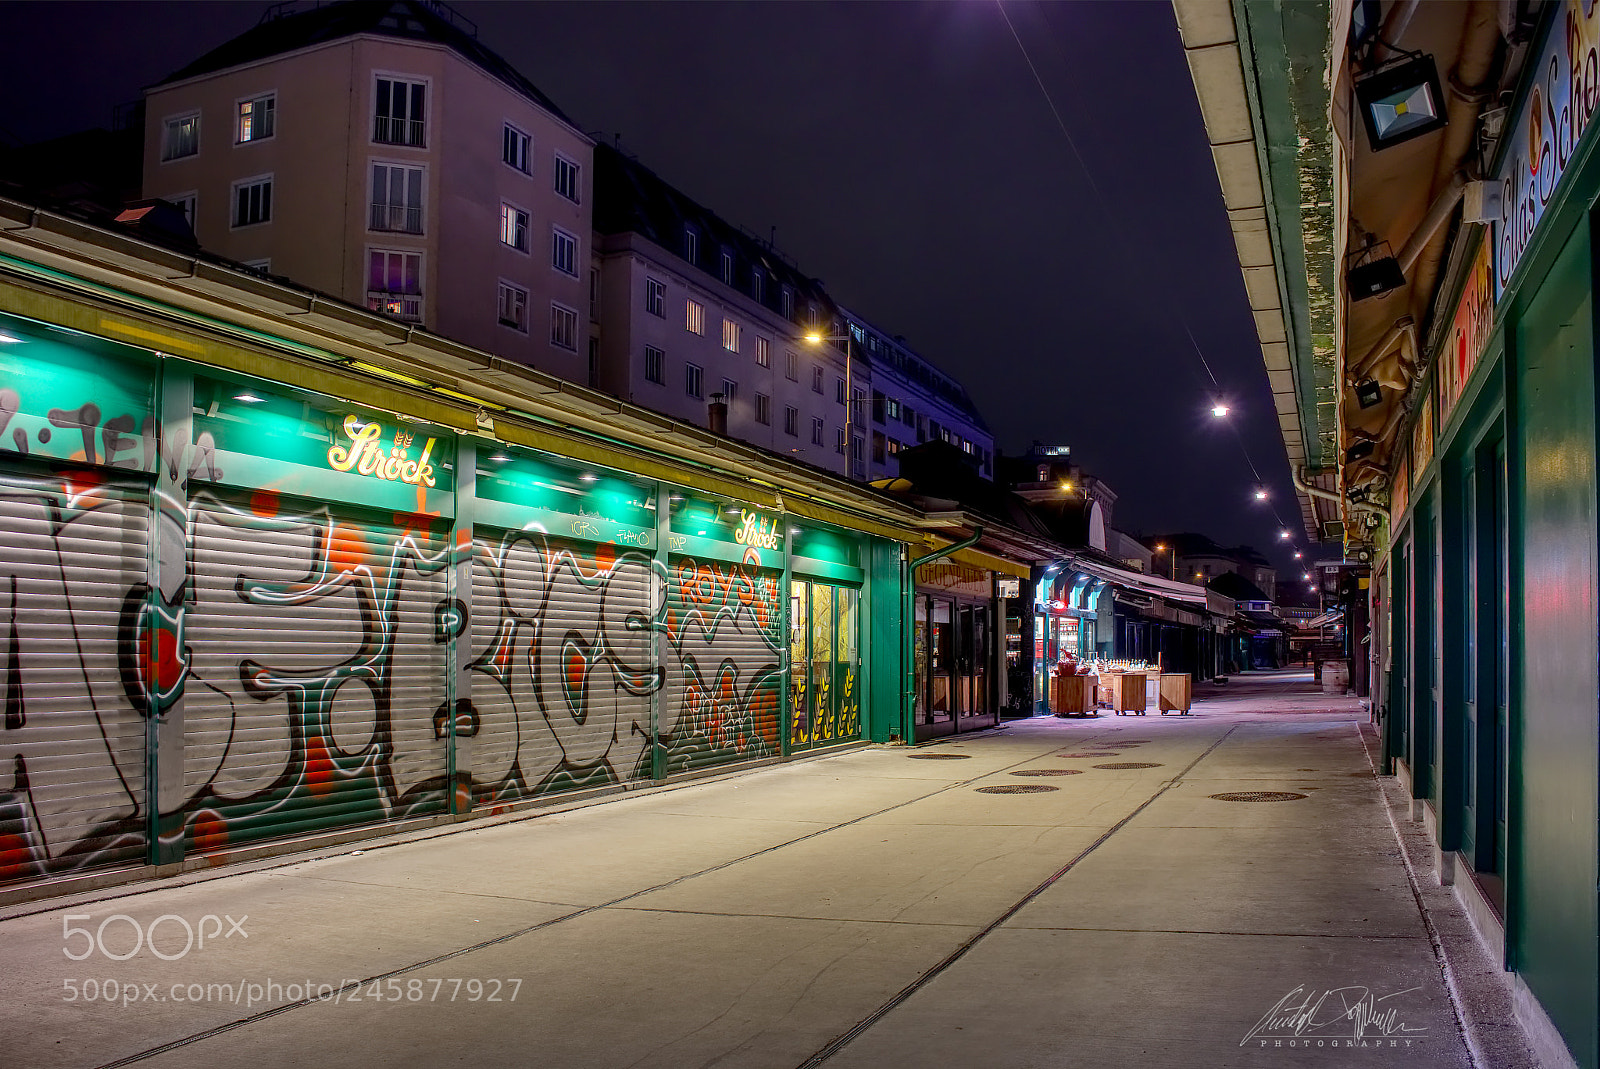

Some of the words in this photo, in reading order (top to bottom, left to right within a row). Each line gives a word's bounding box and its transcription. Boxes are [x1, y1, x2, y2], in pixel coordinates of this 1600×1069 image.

[327, 412, 436, 488] Ströck
[734, 508, 778, 551] Ströck
[920, 563, 987, 593] GEGENBAUER
